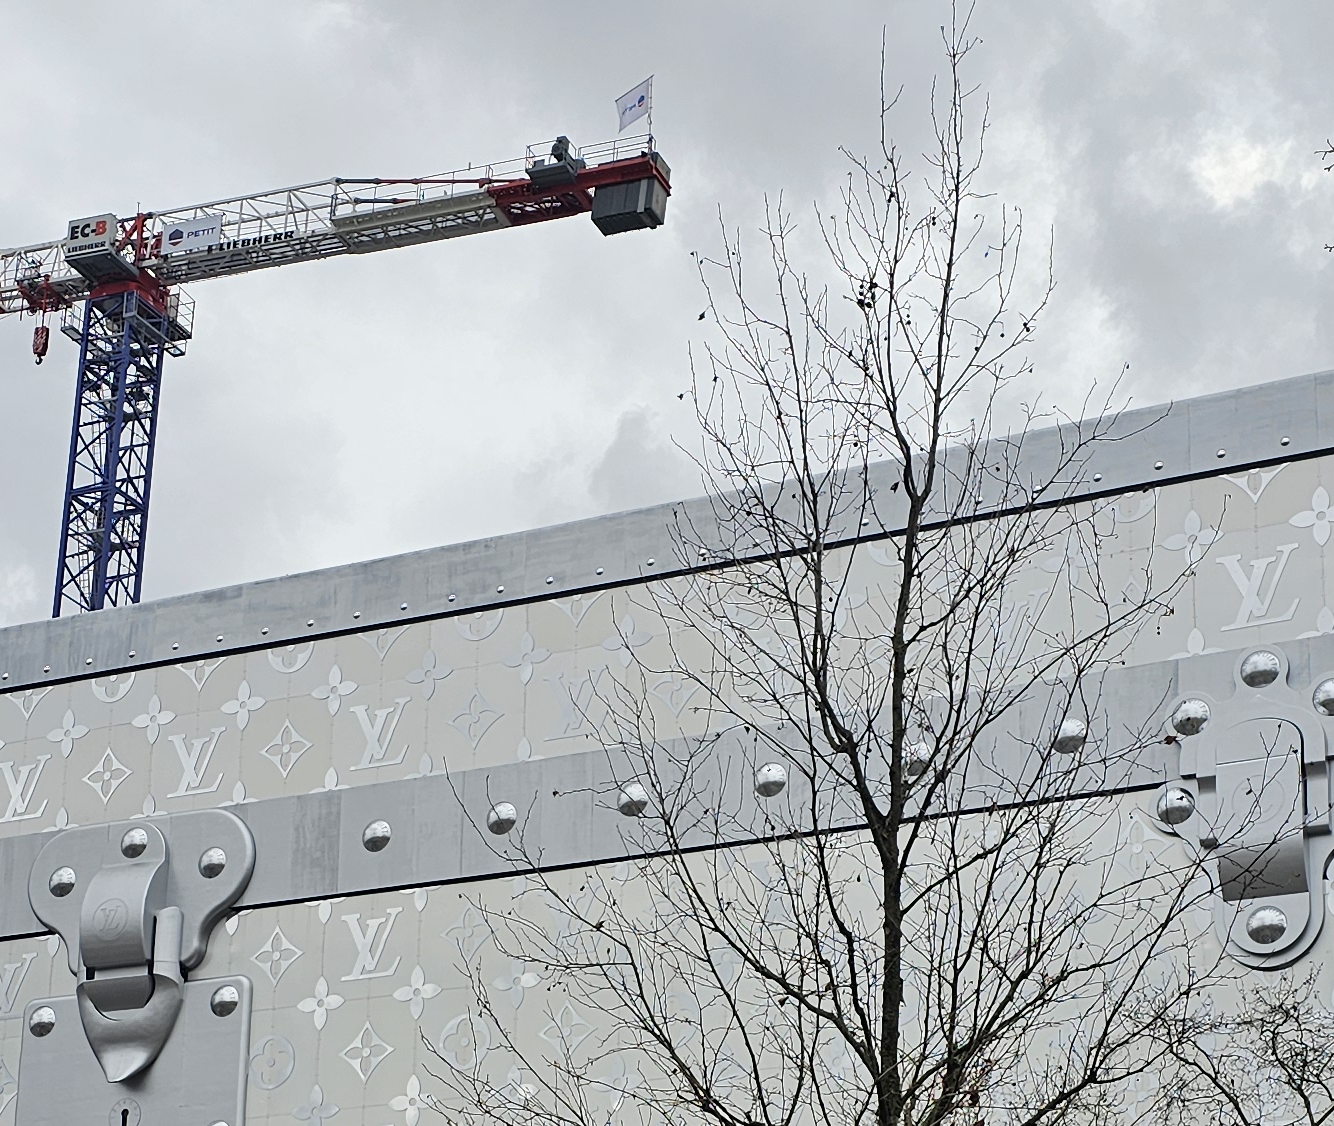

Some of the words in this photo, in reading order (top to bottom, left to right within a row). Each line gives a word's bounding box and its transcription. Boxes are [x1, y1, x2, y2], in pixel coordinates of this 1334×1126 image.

[69, 220, 108, 241] EC-B
[186, 226, 216, 240] PETIT
[67, 240, 107, 254] LIEBHERR
[218, 230, 296, 251] LIEBHERR
